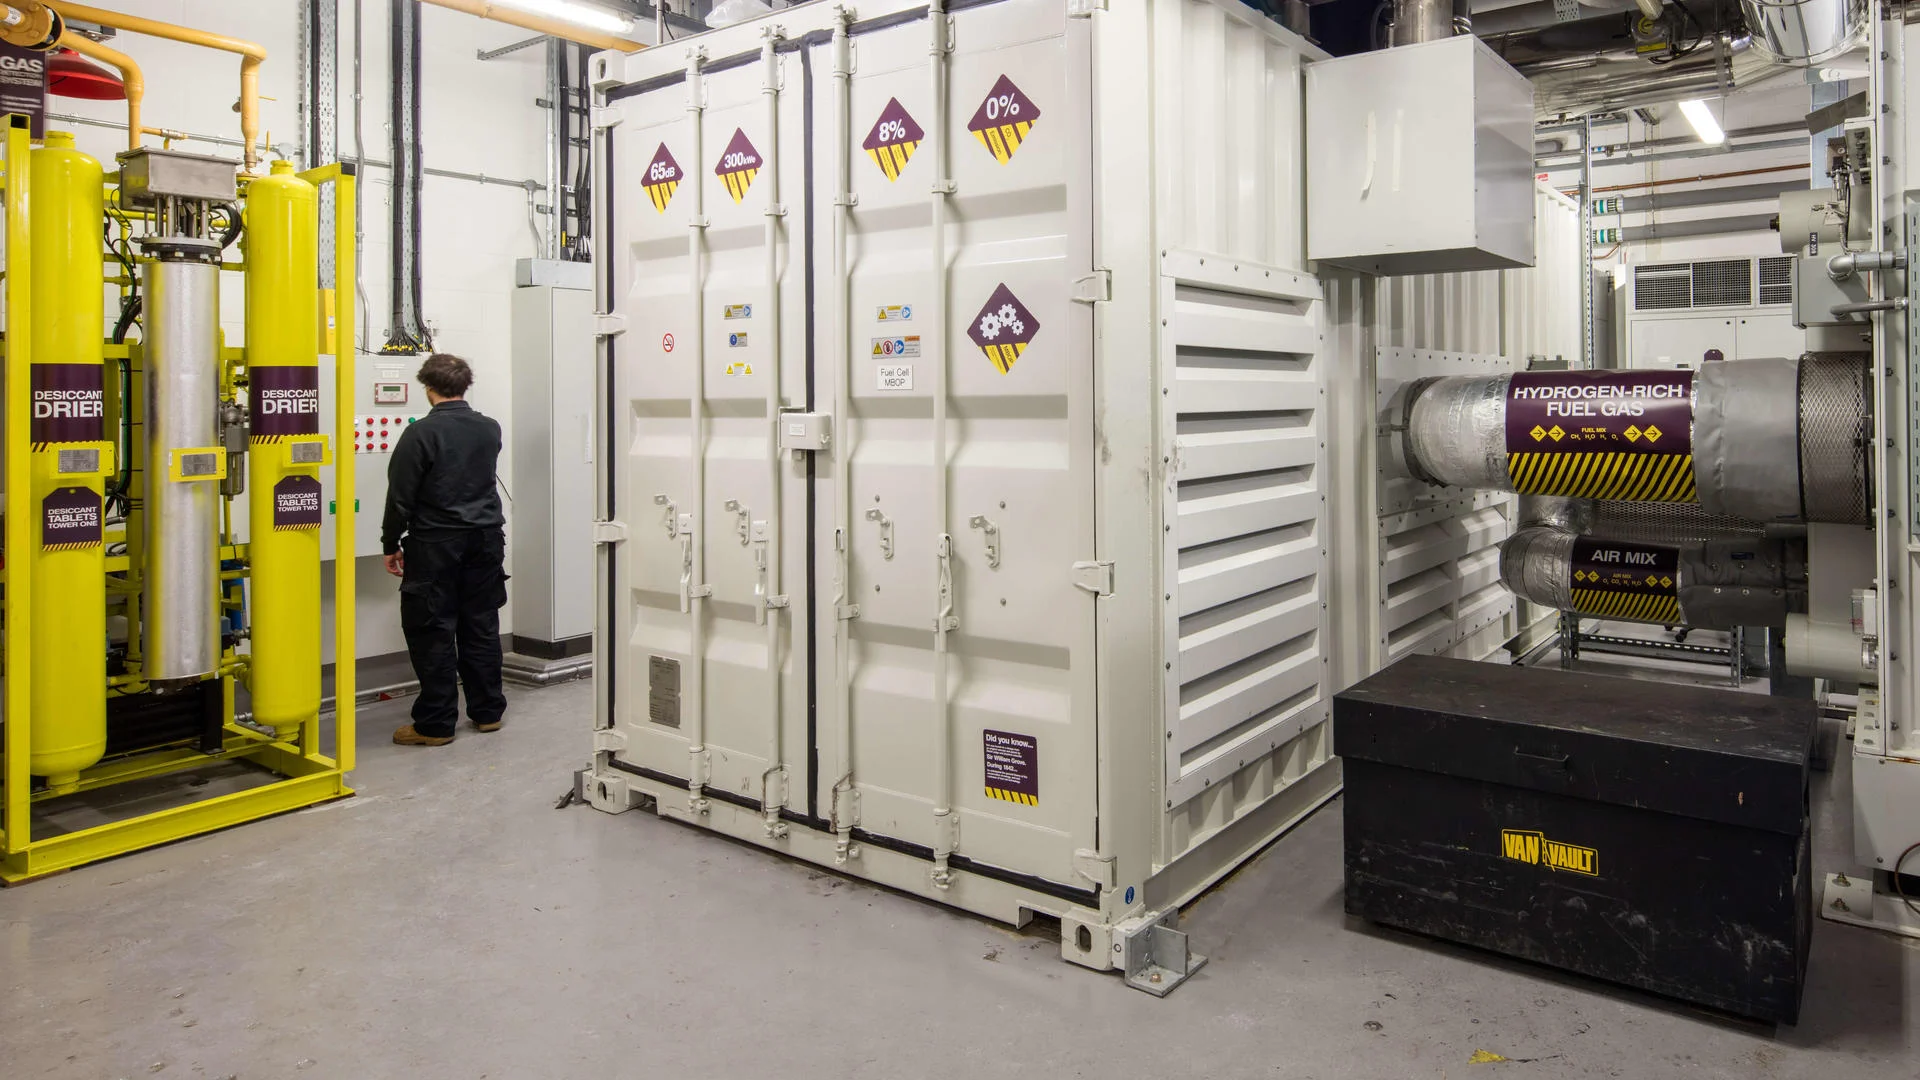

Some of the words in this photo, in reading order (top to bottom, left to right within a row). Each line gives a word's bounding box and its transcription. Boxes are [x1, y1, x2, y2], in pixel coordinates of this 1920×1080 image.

[0, 55, 44, 73] GAS
[986, 93, 1020, 120] 0%
[879, 119, 906, 142] 8%
[724, 152, 757, 169] 300kWe
[651, 161, 676, 181] 65dB
[880, 367, 895, 377] Fuel
[896, 367, 910, 377] Cell
[884, 378, 906, 387] MBOP
[34, 390, 103, 400] DESICCANT
[262, 389, 318, 399] DESICCANT
[1514, 384, 1683, 399] HYDROGEN-RICH
[34, 400, 104, 418] DRIER
[262, 398, 318, 414] DRIER
[1546, 401, 1597, 417] FUEL
[1601, 401, 1645, 417] GAS
[277, 492, 318, 500] DESICCANT
[278, 498, 318, 507] TABLETS
[48, 506, 97, 515] DESICCANT
[48, 513, 97, 523] TABLETS
[79, 520, 98, 528] ONE
[1591, 549, 1620, 562] AIR
[1625, 551, 1657, 565] MIX
[986, 734, 997, 742] Did
[987, 762, 1003, 770] During
[1503, 833, 1540, 865] VAN
[1548, 843, 1594, 872] VAULT
